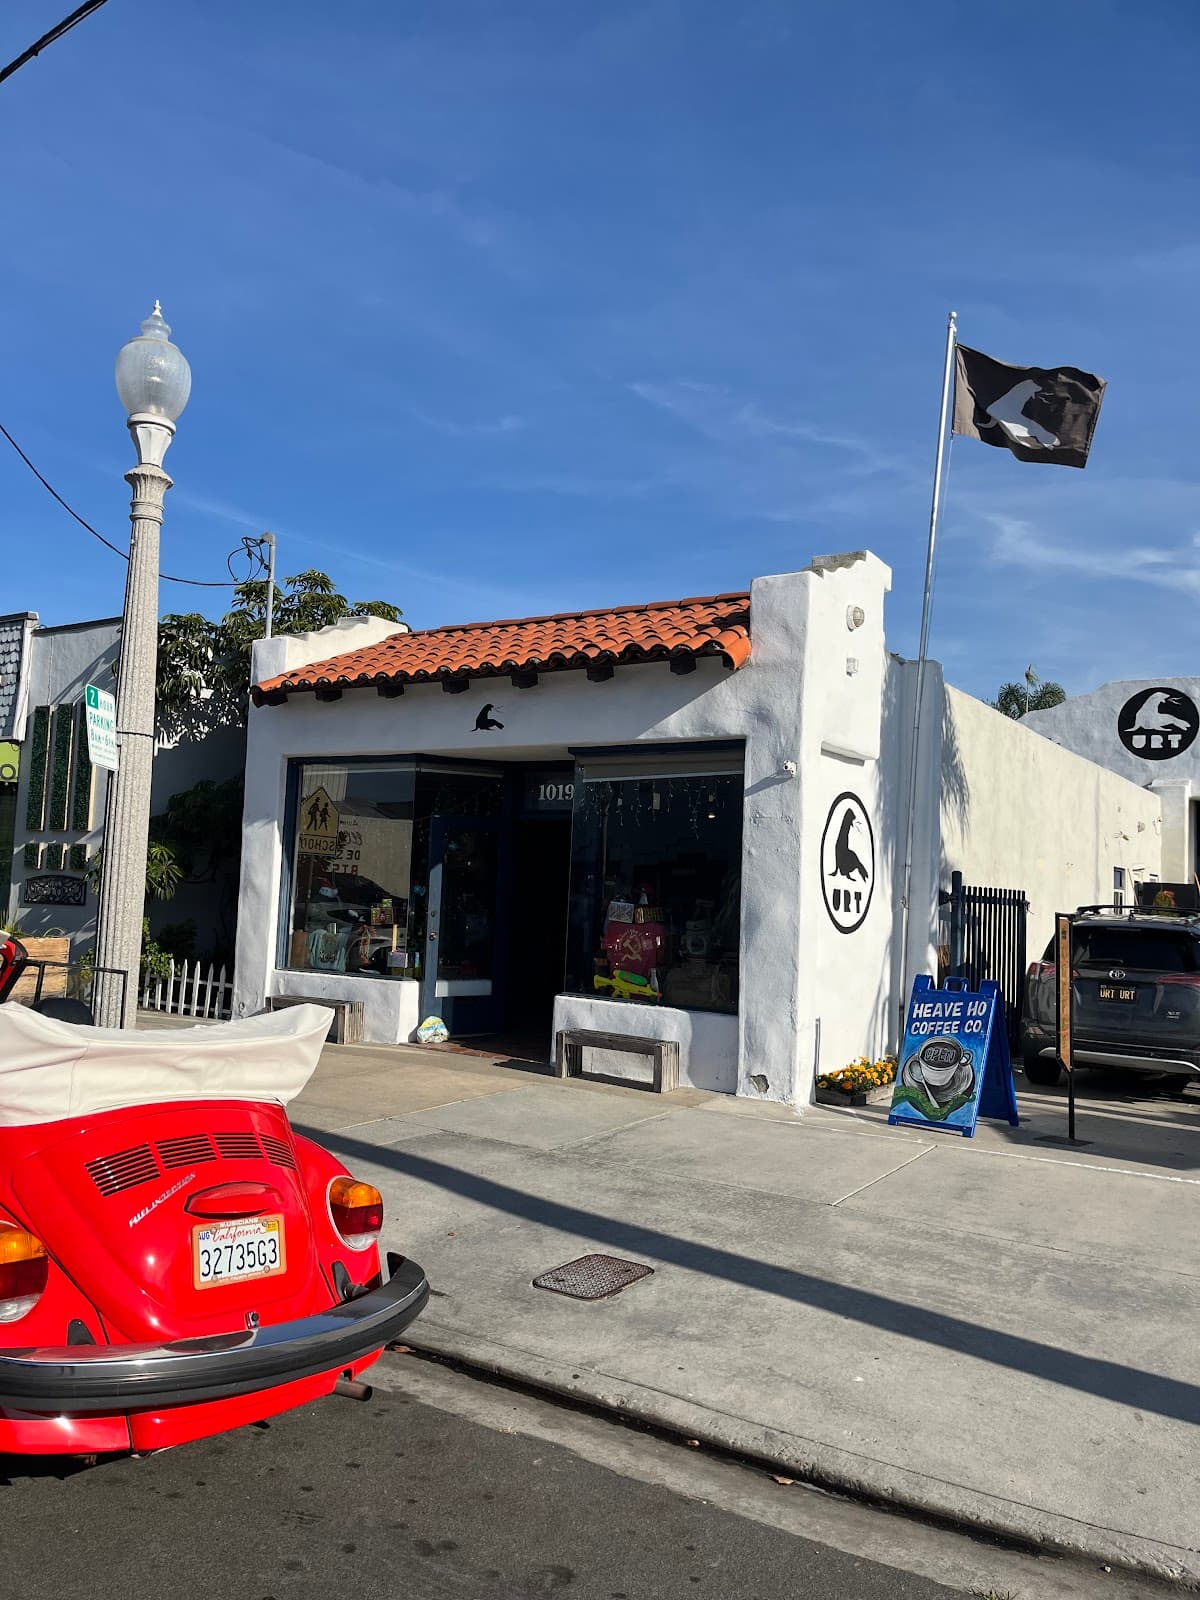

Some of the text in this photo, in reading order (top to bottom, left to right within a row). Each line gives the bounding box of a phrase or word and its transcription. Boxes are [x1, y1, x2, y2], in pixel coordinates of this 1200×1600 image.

[90, 689, 113, 713] 2 HOUR
[89, 711, 114, 732] PARKING
[1131, 734, 1182, 749] URT
[539, 783, 575, 801] 1019
[832, 888, 862, 914] URT
[1100, 989, 1136, 1000] URT URT
[912, 1000, 987, 1019] HEAVE HO
[910, 1020, 961, 1035] COFFEE
[924, 1046, 957, 1064] OPEN
[211, 1226, 265, 1244] California
[201, 1238, 278, 1277] 32735G3
